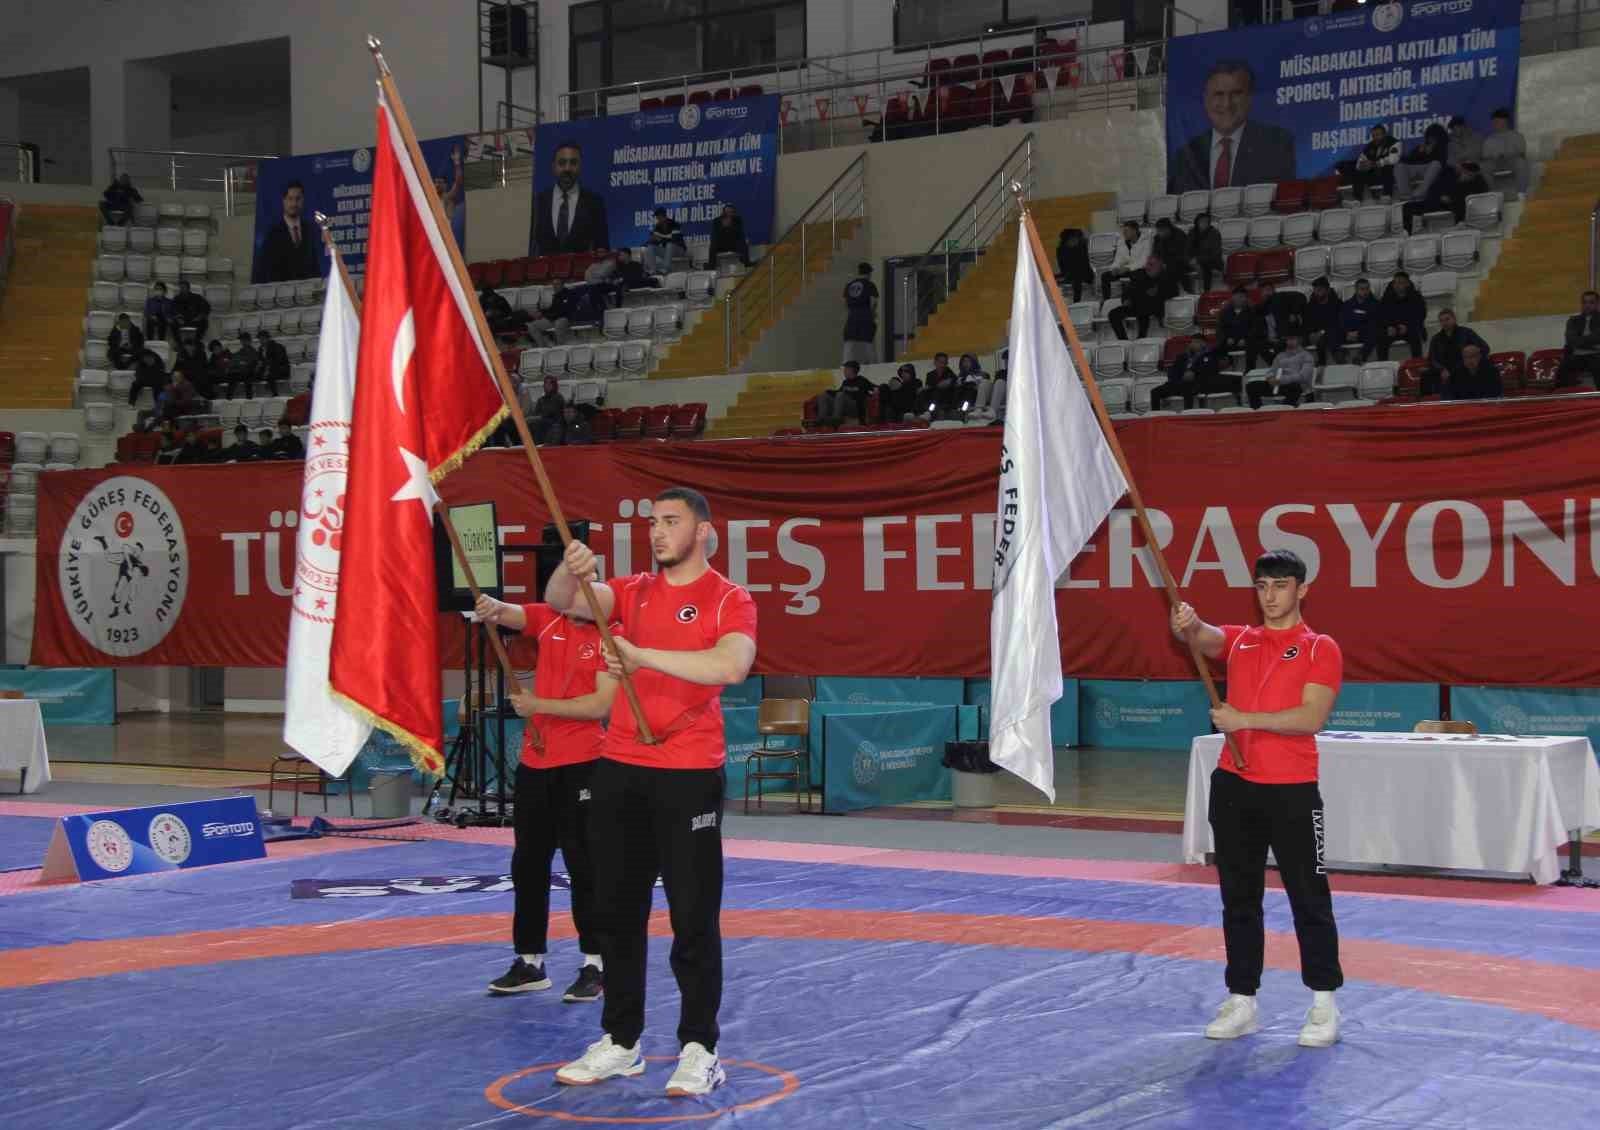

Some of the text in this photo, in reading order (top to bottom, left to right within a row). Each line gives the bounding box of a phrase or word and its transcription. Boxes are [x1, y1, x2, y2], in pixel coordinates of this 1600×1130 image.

[1280, 28, 1496, 78] MÜSABAKALARA KATILAN TÜM
[1276, 81, 1334, 105] SPORCU,
[1421, 61, 1474, 86] HAKEM
[1479, 57, 1497, 77] VE
[1340, 93, 1428, 122] İDARECİLERE
[613, 132, 761, 165] MÜSABAKALARA KATILAN TÜM
[1311, 123, 1389, 153] BAŞARIL
[710, 159, 747, 178] HAKEM
[750, 157, 763, 174] VE
[65, 538, 95, 625] TÜRKİYE
[81, 487, 126, 530] GÜREŞ
[133, 489, 181, 622] FEDERASYONU
[106, 628, 140, 643] 1923
